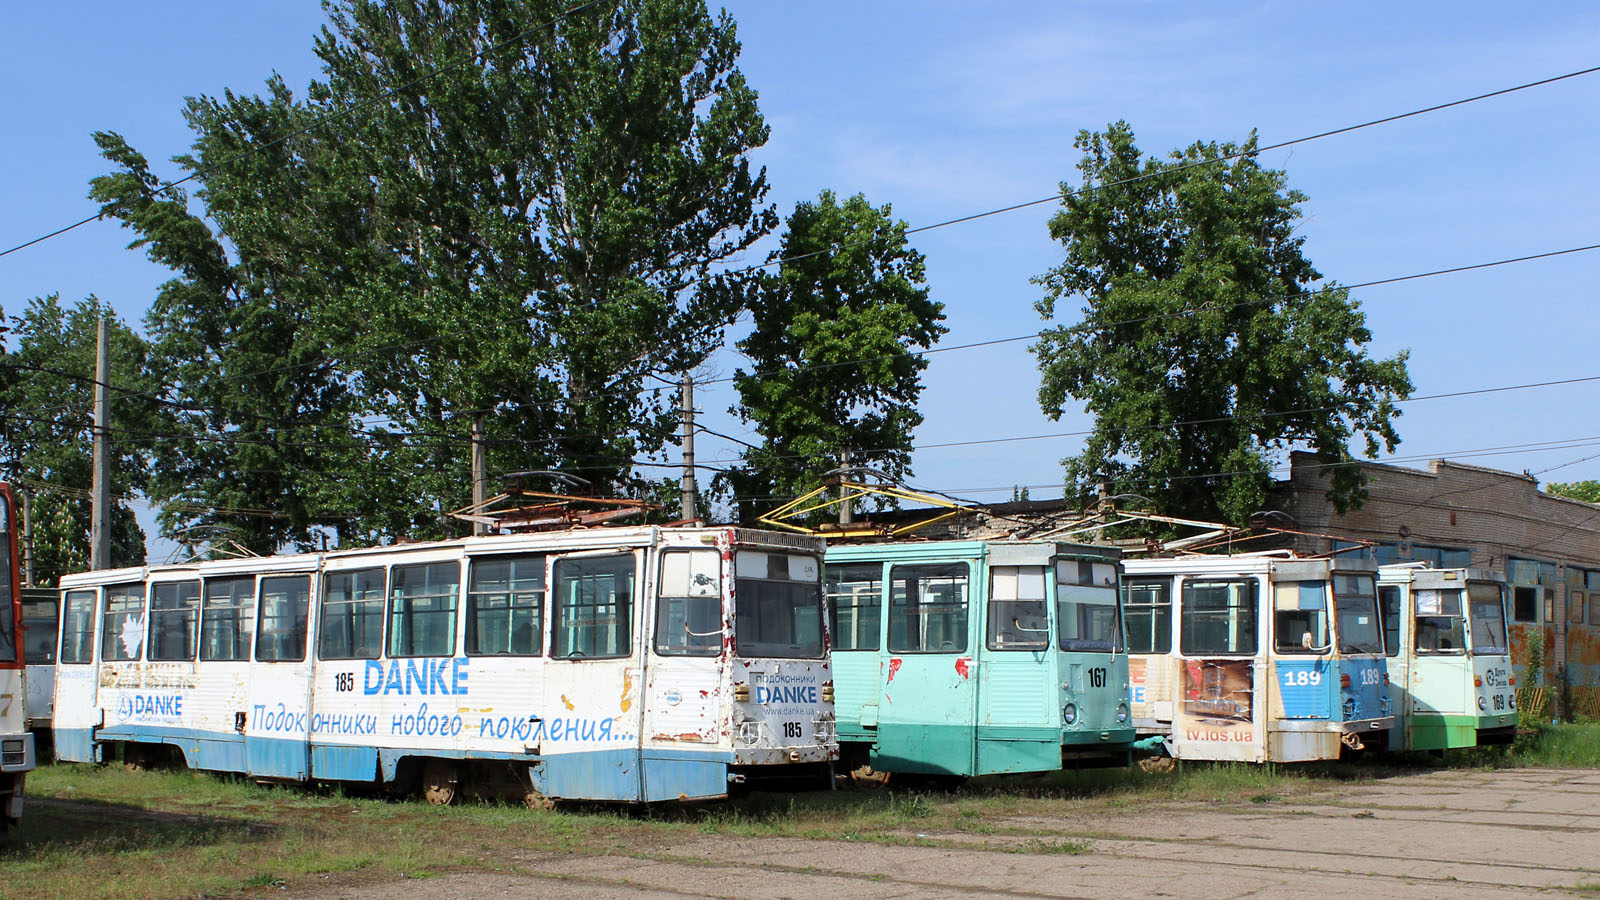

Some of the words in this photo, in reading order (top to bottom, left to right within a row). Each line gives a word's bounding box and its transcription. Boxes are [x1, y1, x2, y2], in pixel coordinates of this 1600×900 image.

[334, 672, 354, 692] 185
[364, 657, 470, 696] DANKE
[1088, 667, 1107, 688] 167
[1284, 671, 1321, 686] 189
[1360, 669, 1380, 685] 189
[757, 686, 817, 704] DANKE
[135, 695, 183, 715] DANKE
[763, 707, 815, 716] www.danke.ua
[252, 702, 377, 735] Подоконники
[391, 702, 463, 737] нового
[479, 714, 635, 742] поколения...
[783, 722, 802, 738] 185
